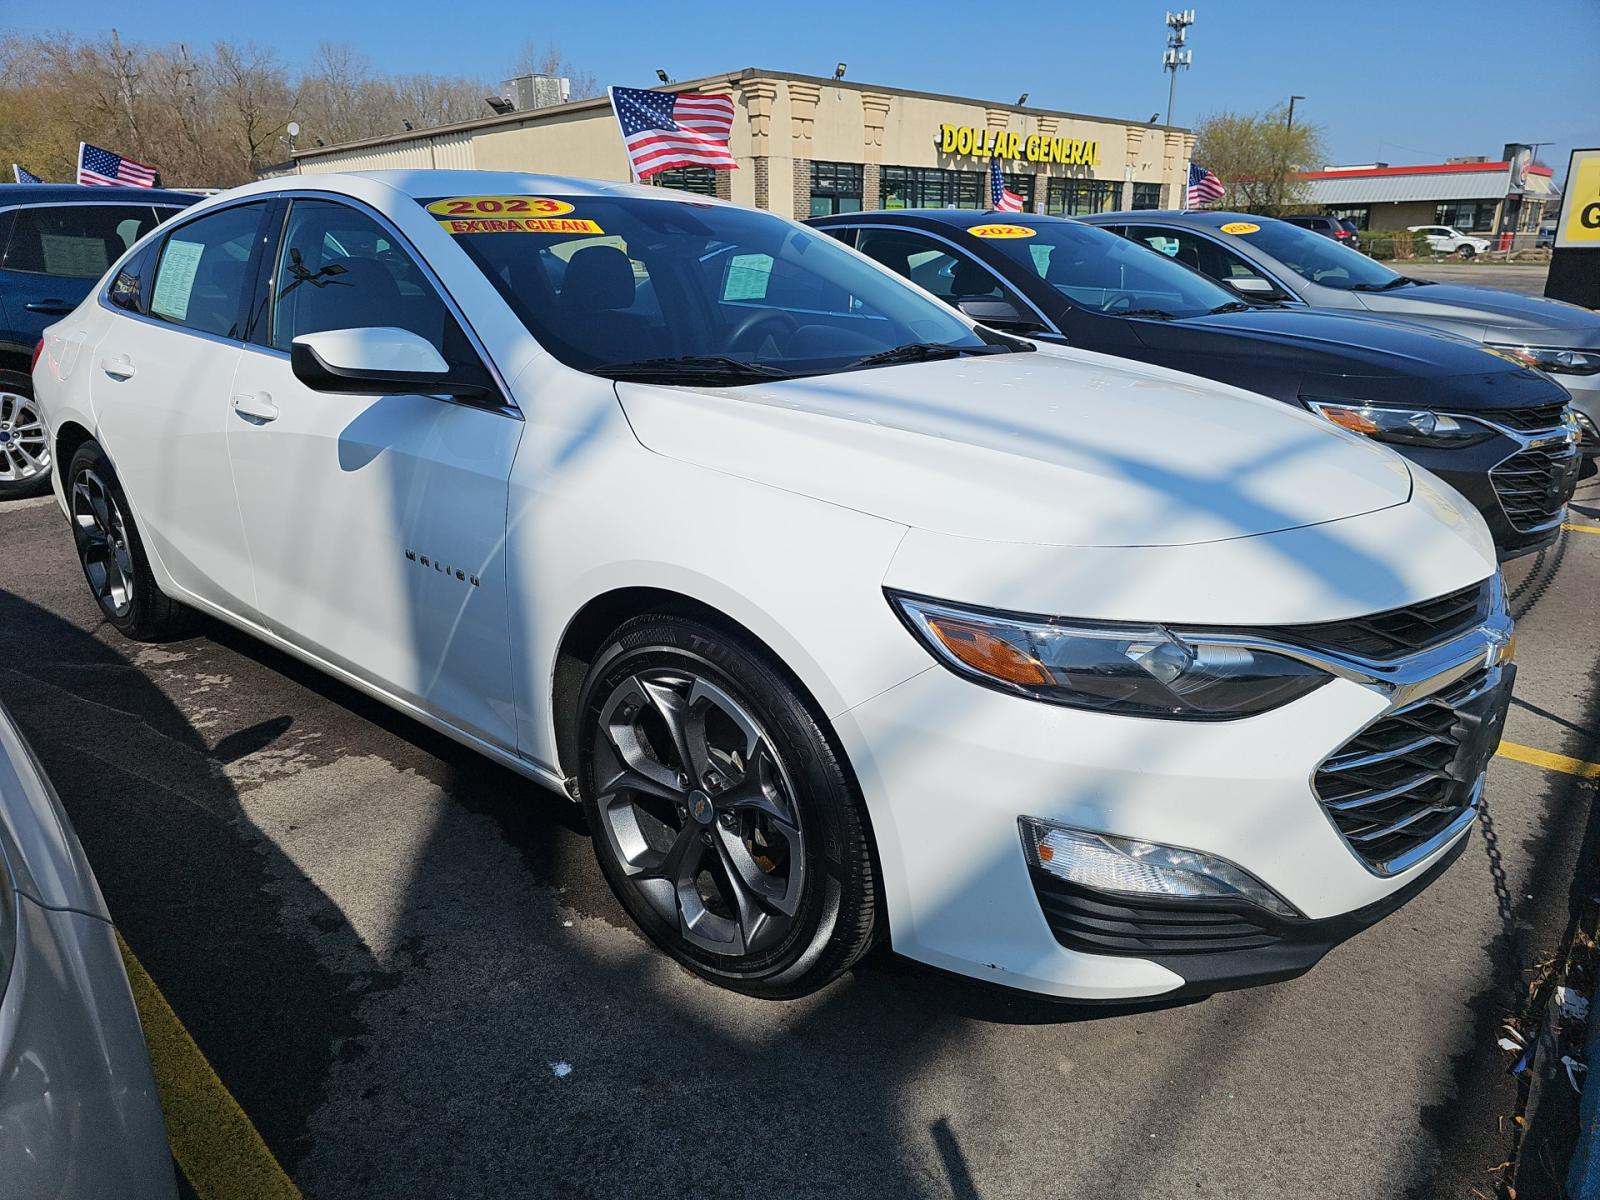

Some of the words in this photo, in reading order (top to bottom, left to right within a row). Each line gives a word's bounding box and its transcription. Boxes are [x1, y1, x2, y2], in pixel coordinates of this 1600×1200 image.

[940, 123, 1022, 160] DOLLAR
[1026, 133, 1102, 166] GENERAL
[446, 198, 561, 215] 2023
[450, 219, 523, 232] EXTRA
[525, 219, 590, 232] CLEAN
[976, 227, 1029, 236] 2023
[404, 549, 480, 587] MALIBU
